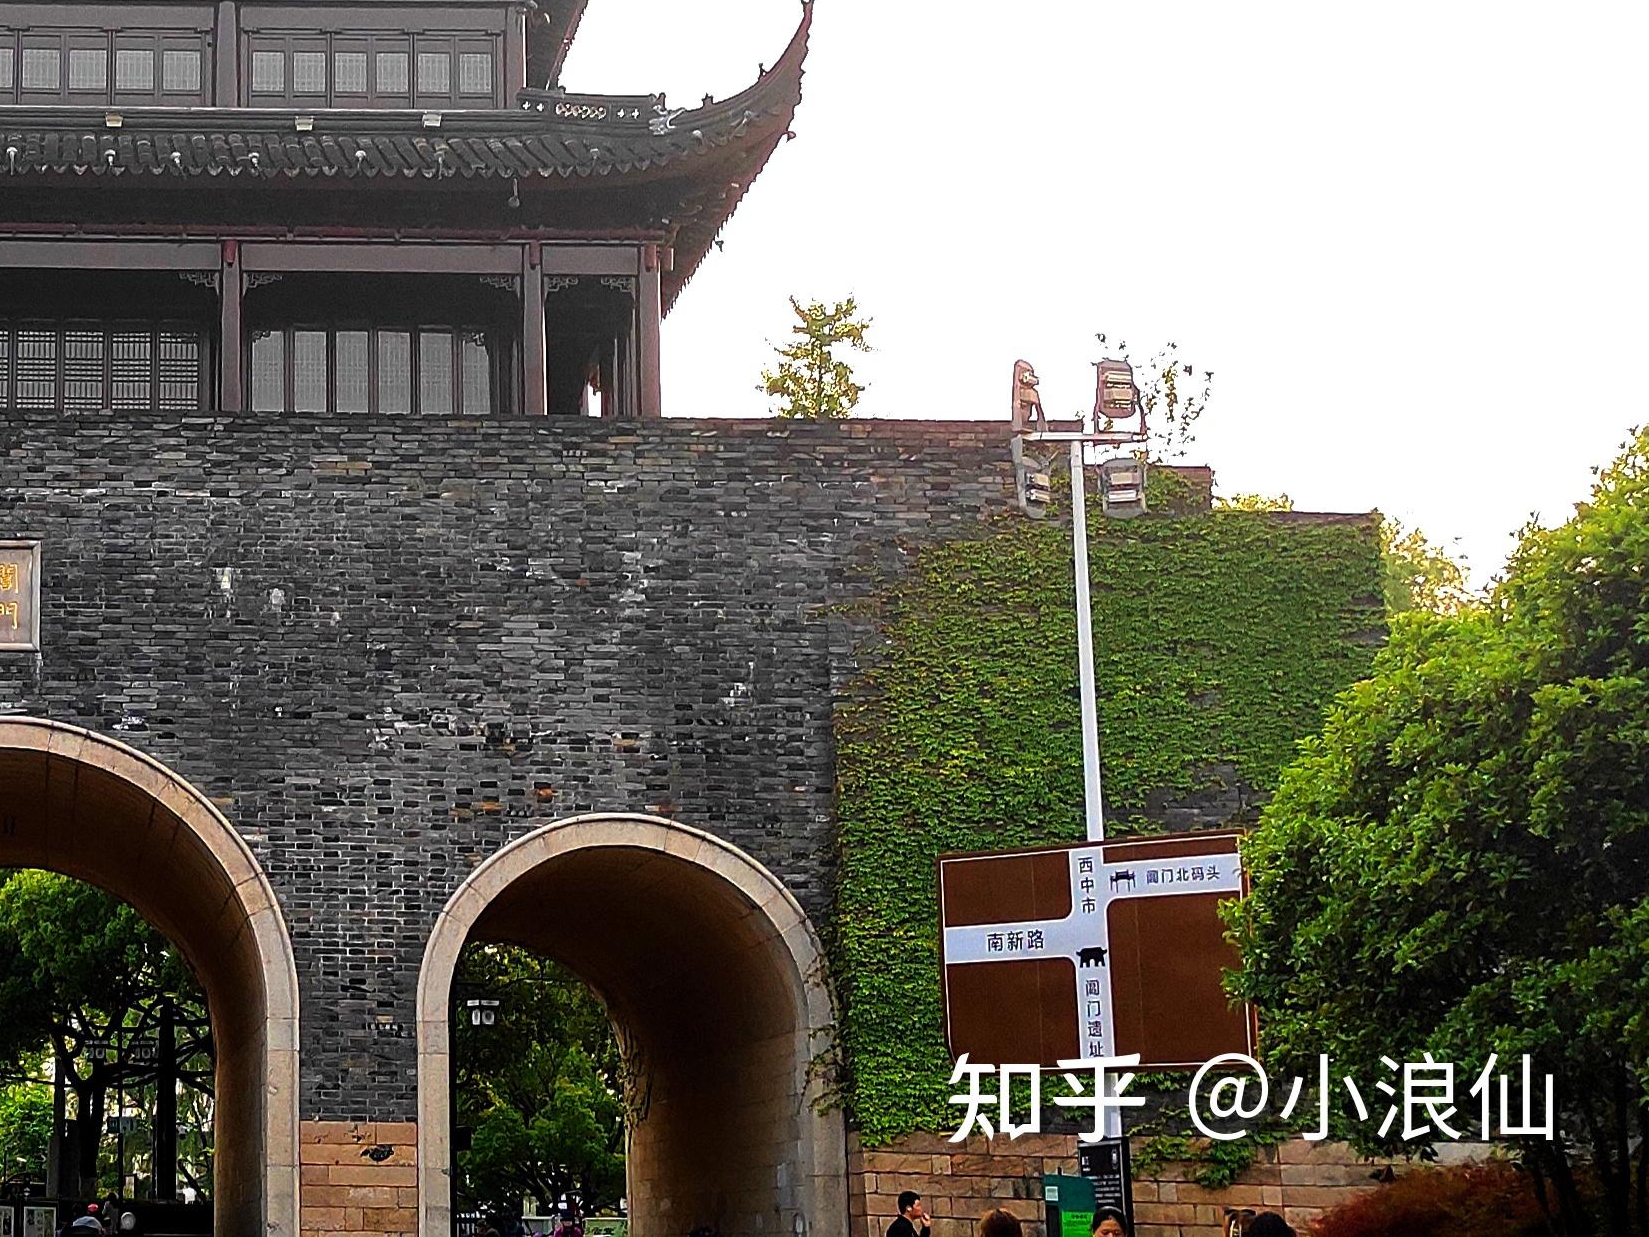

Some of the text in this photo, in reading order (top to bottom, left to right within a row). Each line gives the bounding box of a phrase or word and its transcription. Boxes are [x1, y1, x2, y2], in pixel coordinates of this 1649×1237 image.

[1078, 857, 1096, 914] 西中市
[1146, 865, 1220, 884] 阊门北码头
[986, 929, 1045, 953] 南新路
[1086, 979, 1104, 1058] 阊门遗址
